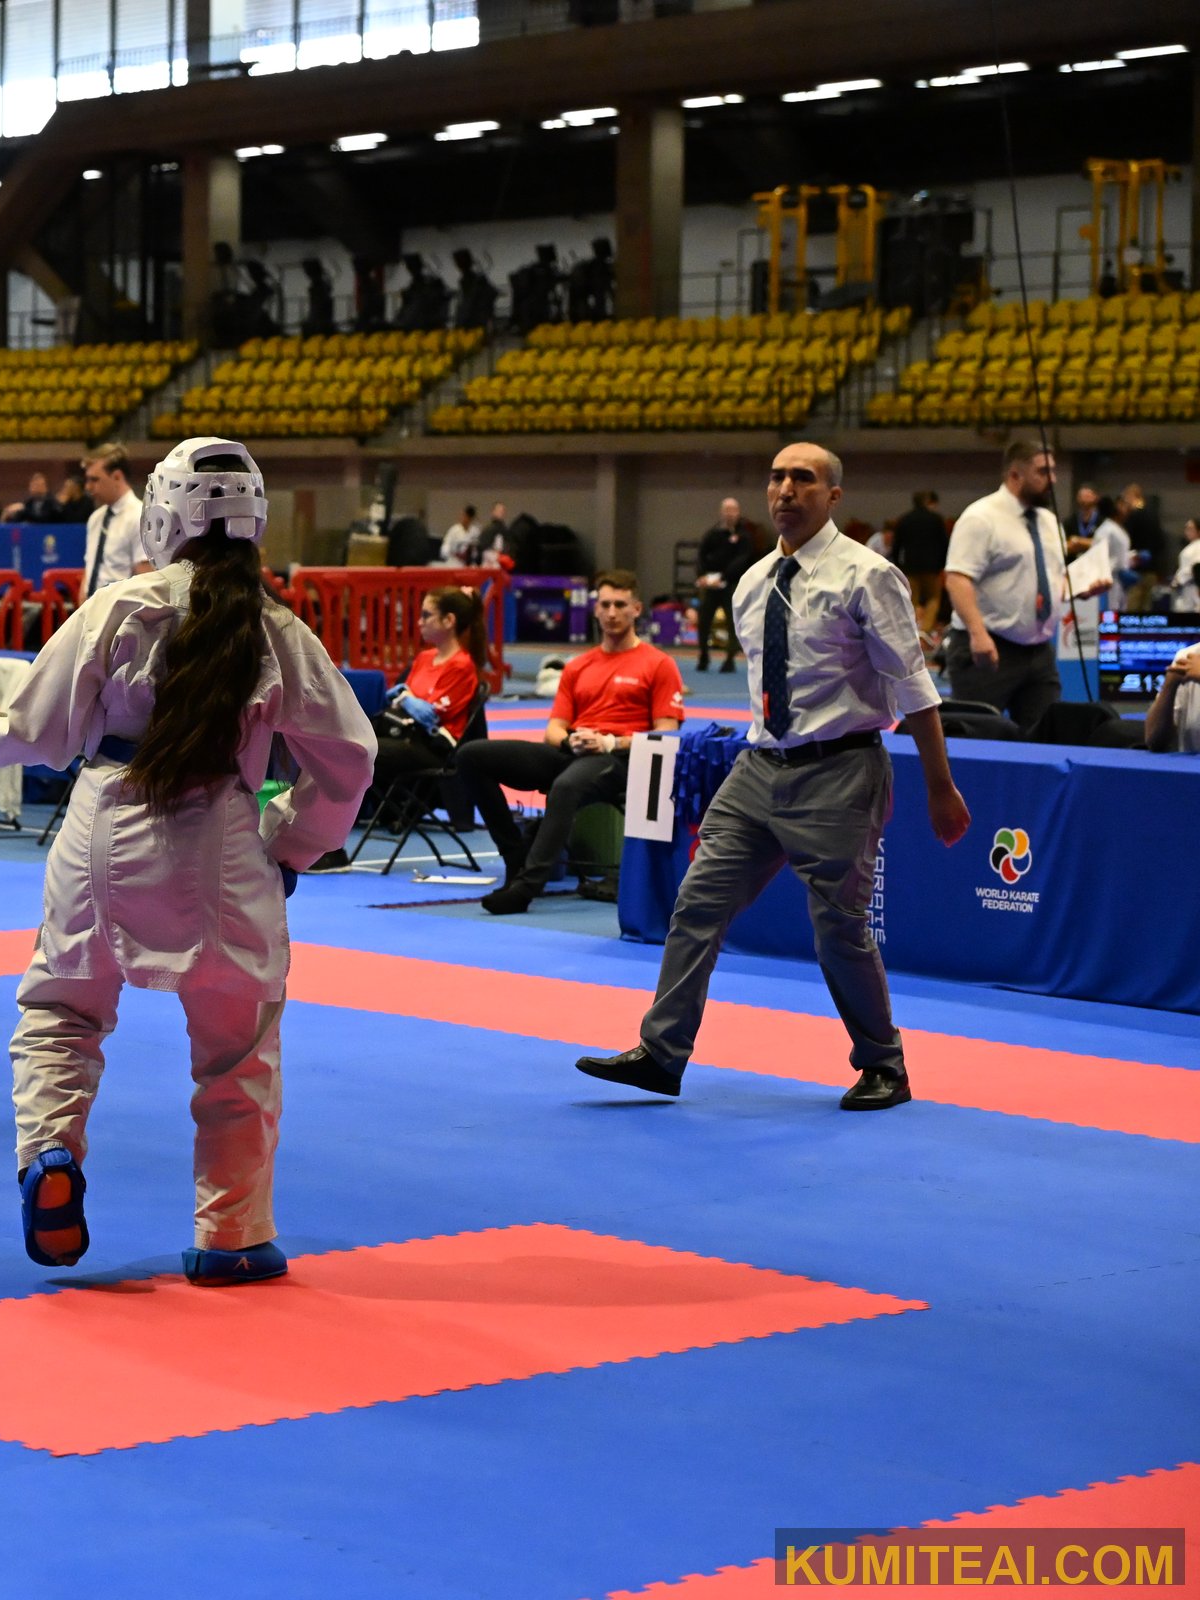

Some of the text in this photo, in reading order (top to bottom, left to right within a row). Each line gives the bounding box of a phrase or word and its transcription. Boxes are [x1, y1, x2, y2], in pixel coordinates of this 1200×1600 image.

[975, 887, 1040, 903] WORLD KARATE
[982, 899, 1034, 913] FEDERATION
